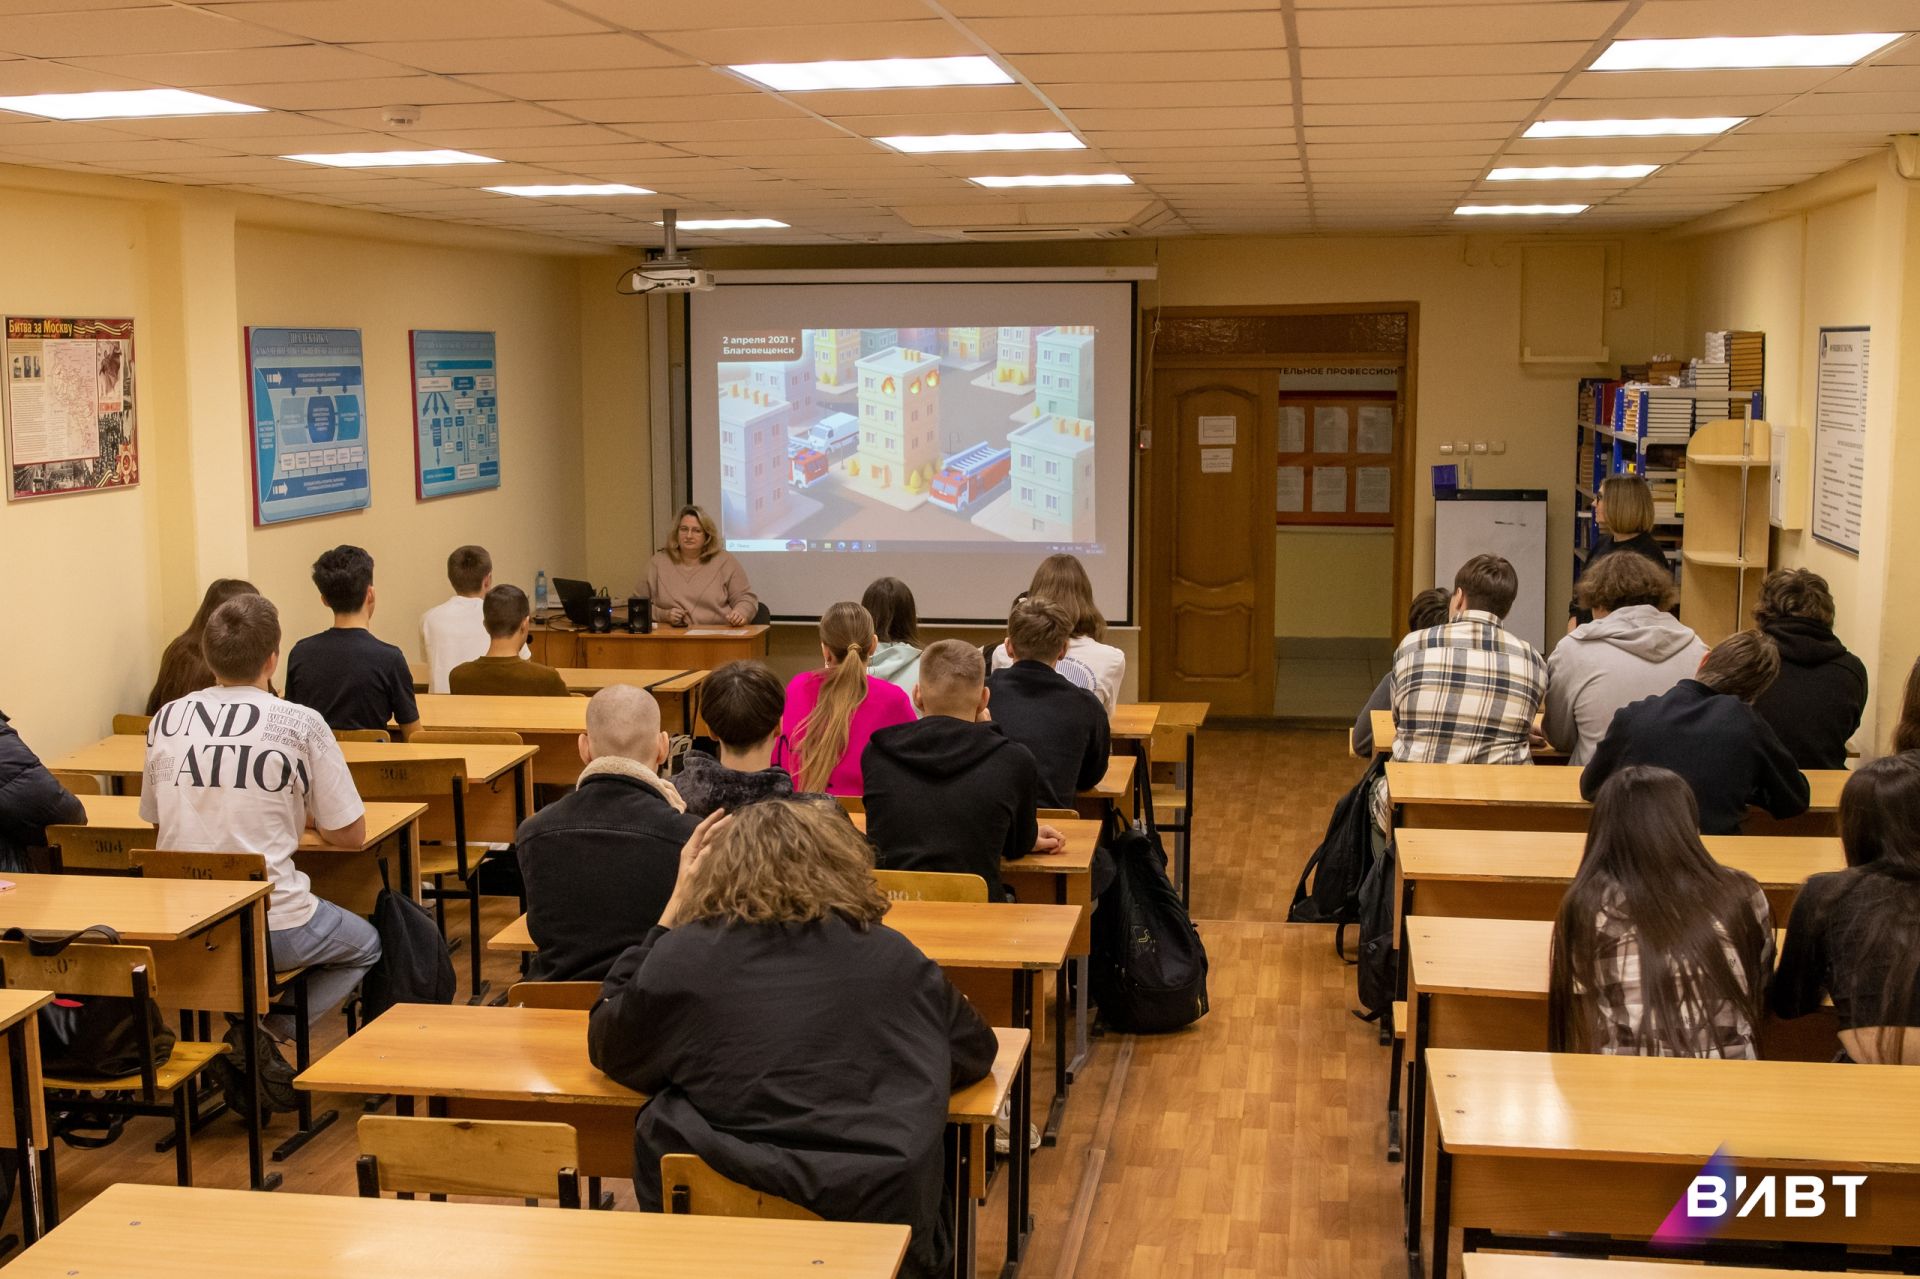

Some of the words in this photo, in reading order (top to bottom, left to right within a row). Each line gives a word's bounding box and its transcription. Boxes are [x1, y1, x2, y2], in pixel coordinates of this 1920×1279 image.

[9, 320, 32, 333] Битва
[33, 323, 42, 333] за
[44, 320, 73, 336] Москву
[722, 336, 729, 345] 2
[731, 337, 766, 345] апреля
[768, 336, 789, 344] 2021
[723, 347, 795, 355] Благовещенск
[267, 712, 301, 730] WHEN
